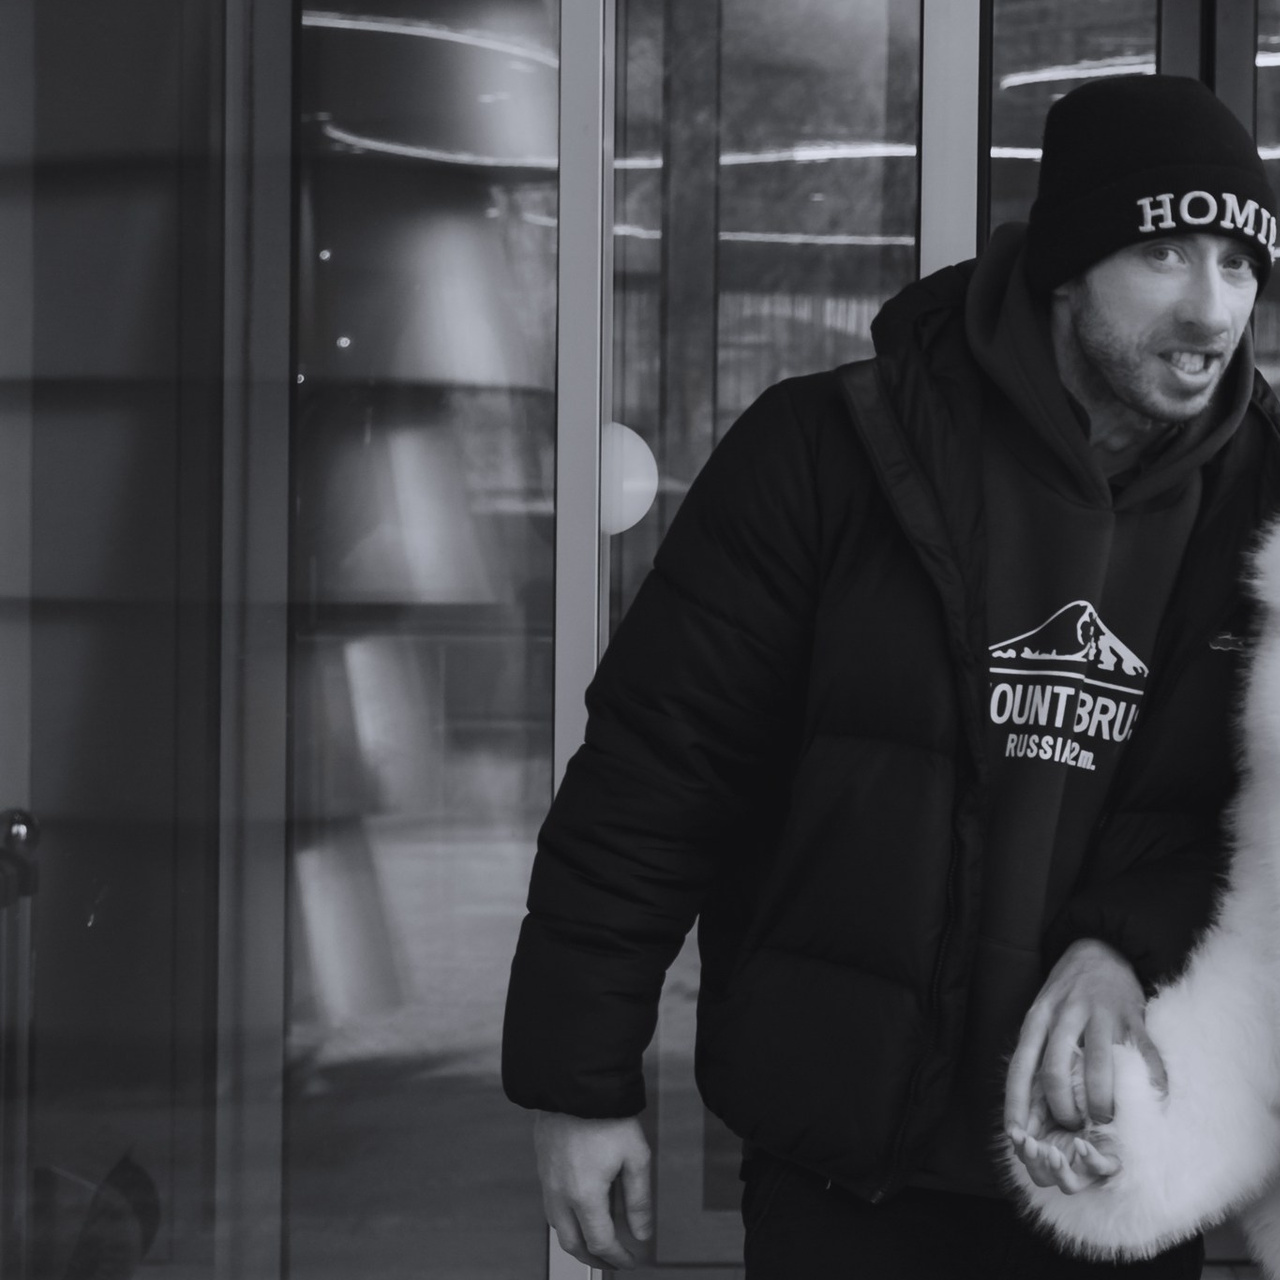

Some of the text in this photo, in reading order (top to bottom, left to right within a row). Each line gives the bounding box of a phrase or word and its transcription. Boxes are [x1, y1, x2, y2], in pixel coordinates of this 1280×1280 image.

[1136, 190, 1277, 254] HOMI
[989, 682, 1140, 743] OUNT BRU
